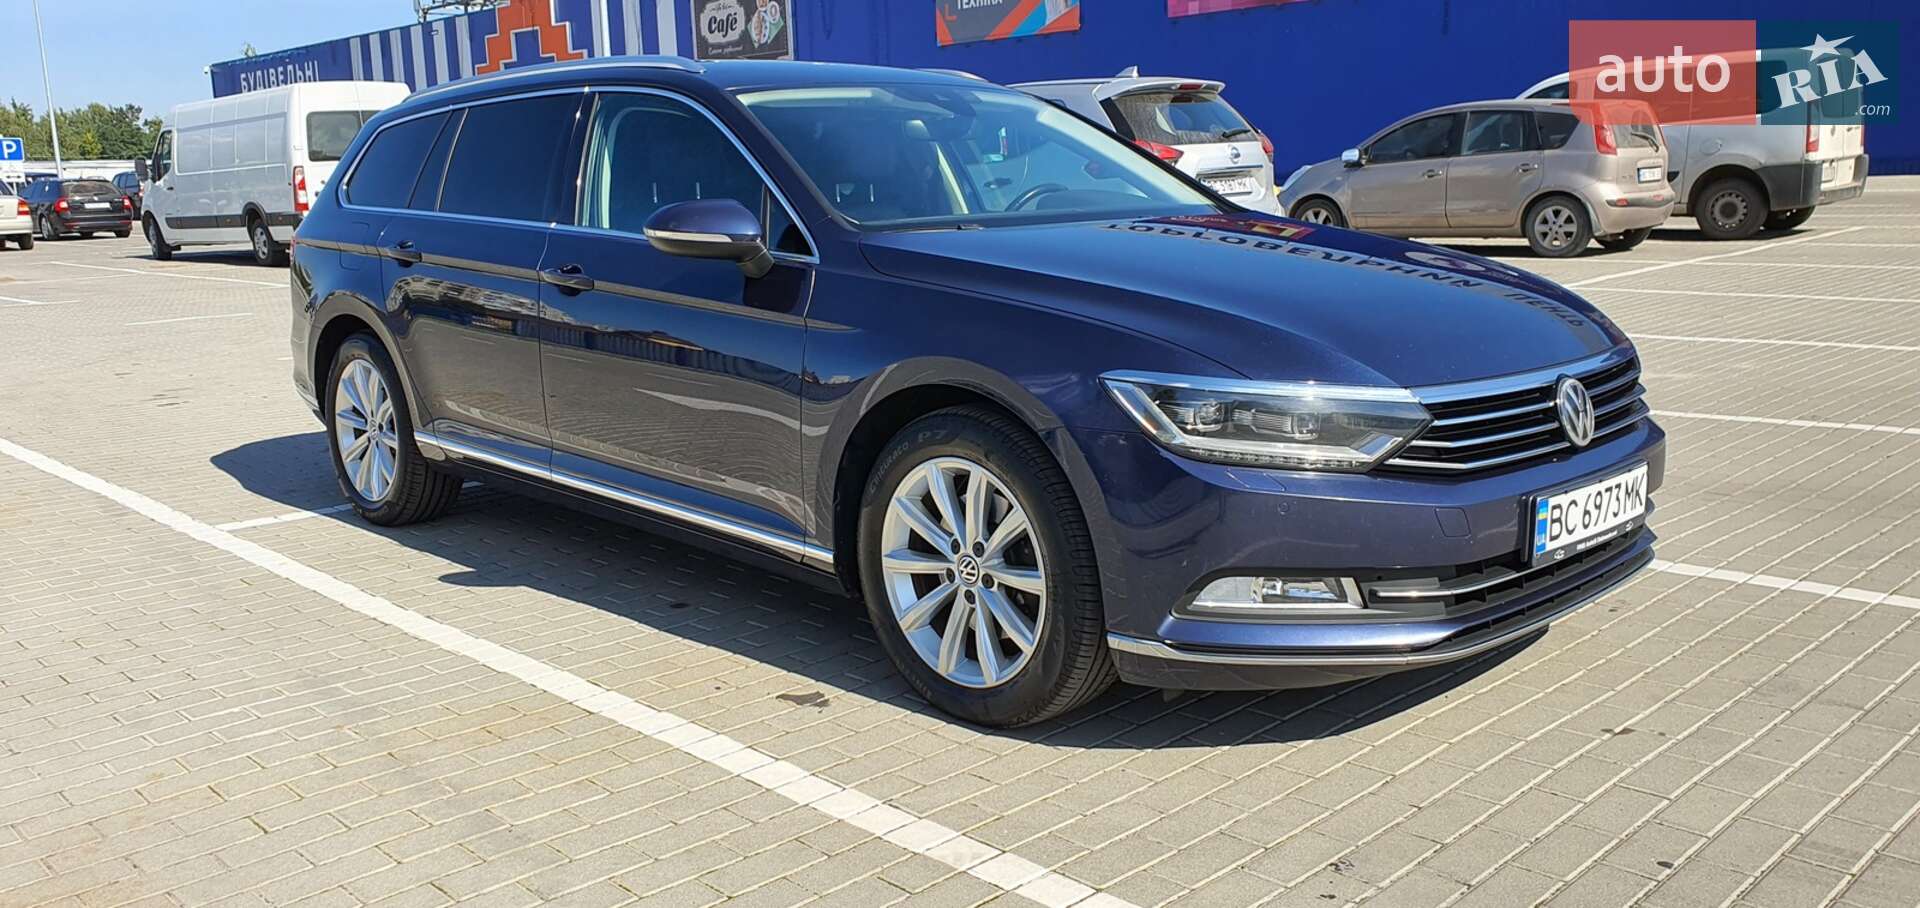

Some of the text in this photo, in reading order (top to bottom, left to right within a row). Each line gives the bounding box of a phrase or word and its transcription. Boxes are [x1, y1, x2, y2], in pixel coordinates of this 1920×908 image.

[707, 12, 738, 38] Café
[240, 60, 319, 94] БУДІВЕЛЬНІ
[2, 140, 17, 159] P
[1549, 499, 1579, 542] BC
[1582, 483, 1622, 530] 6973
[1624, 472, 1645, 514] MK
